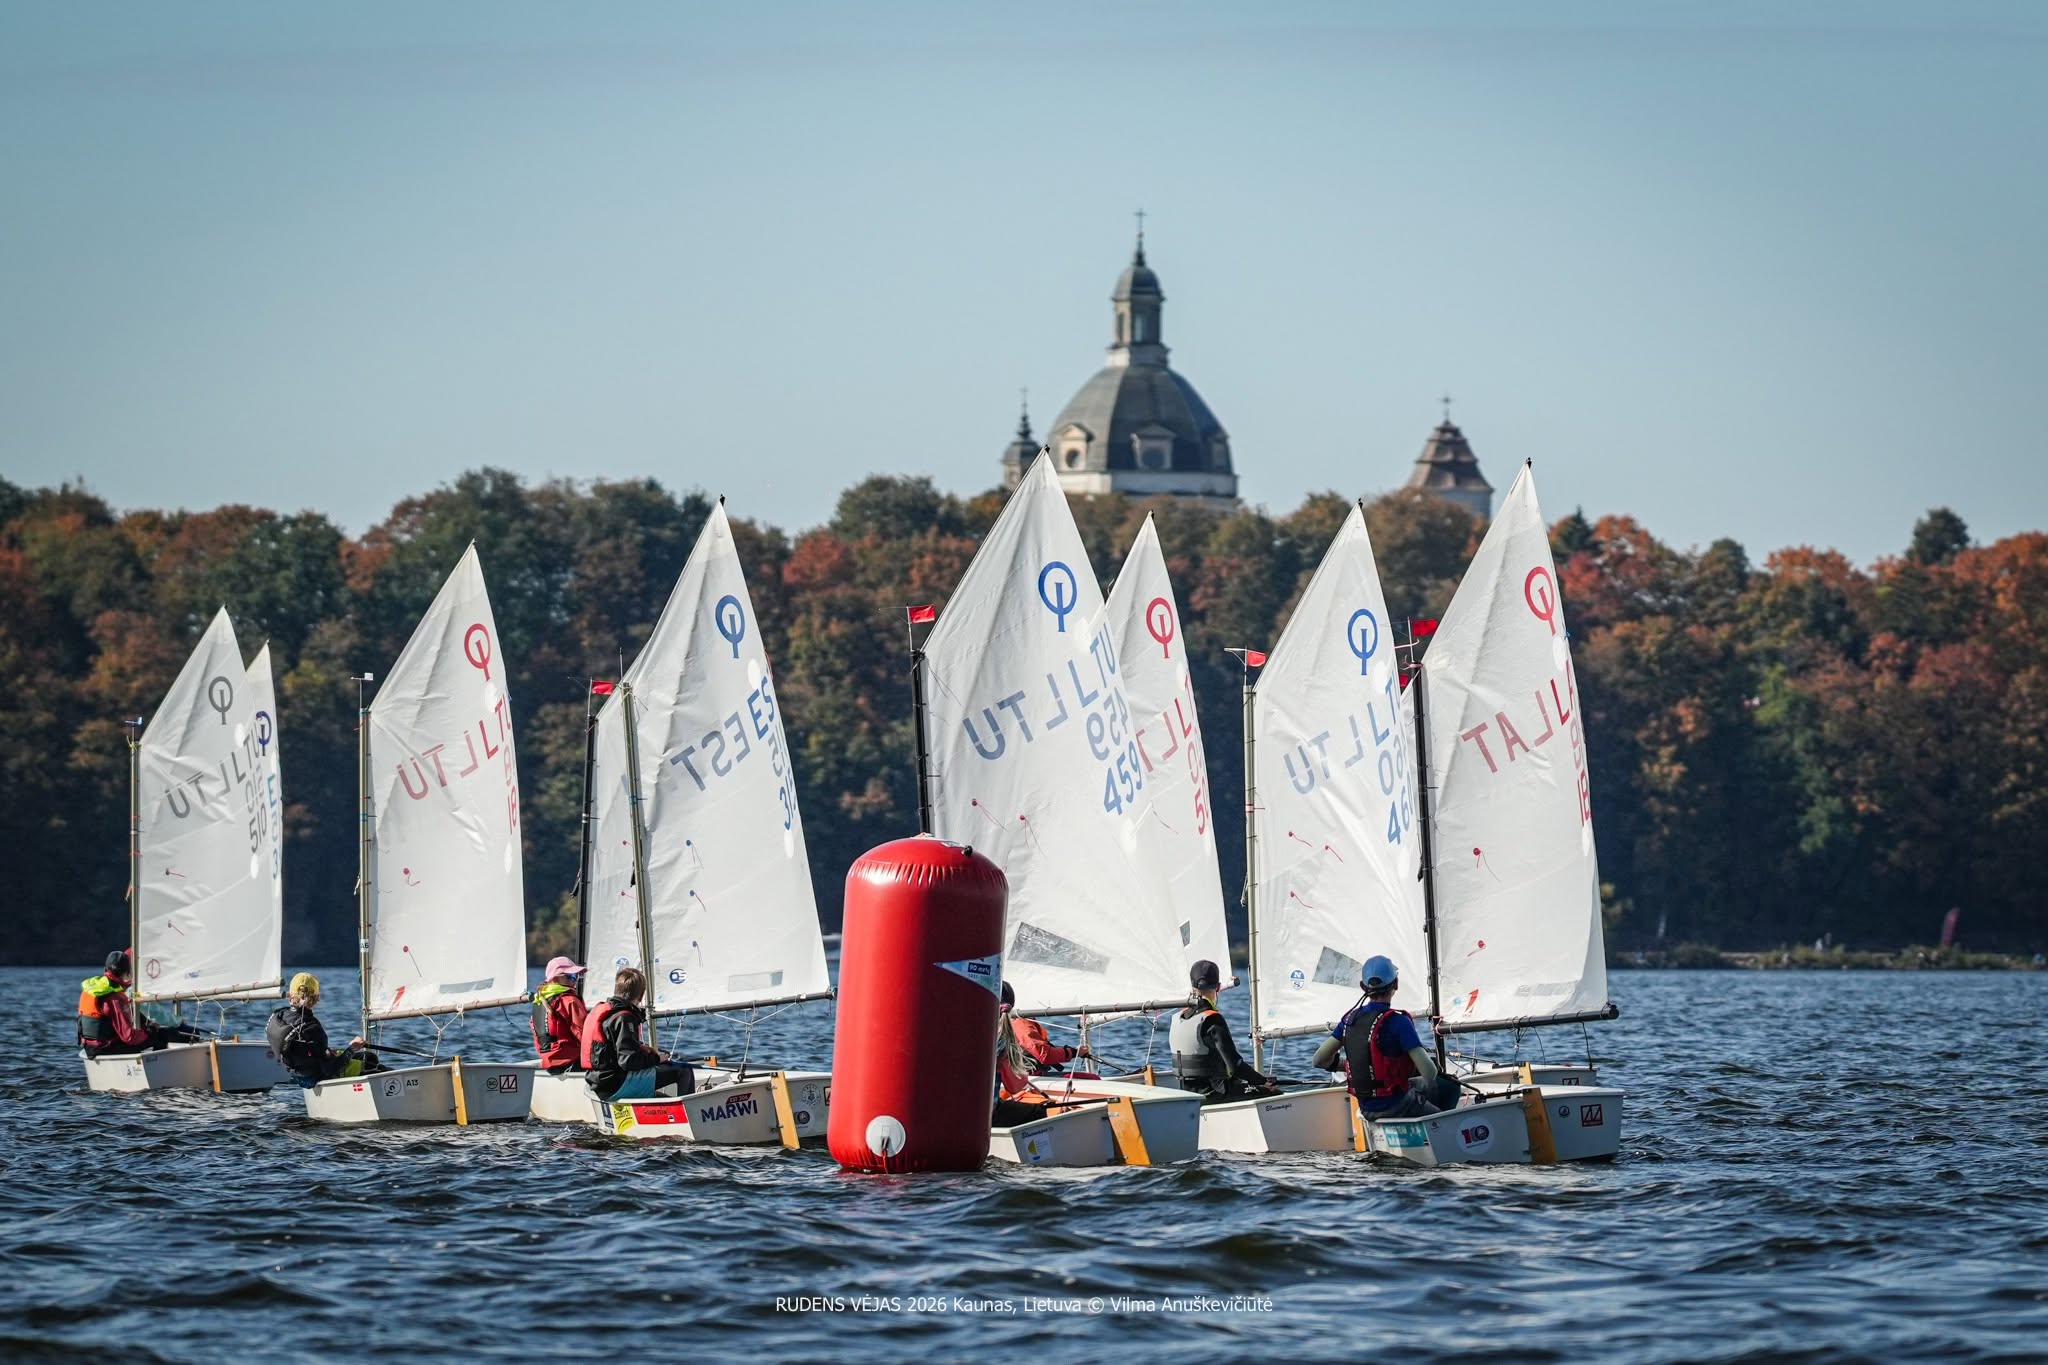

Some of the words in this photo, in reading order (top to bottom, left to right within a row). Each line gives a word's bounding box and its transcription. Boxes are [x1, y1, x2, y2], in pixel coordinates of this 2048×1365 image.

[1067, 622, 1116, 708] LTU
[747, 667, 775, 740] ES
[1103, 740, 1142, 816] 459
[249, 803, 268, 853] 510
[701, 1099, 758, 1123] MARWI
